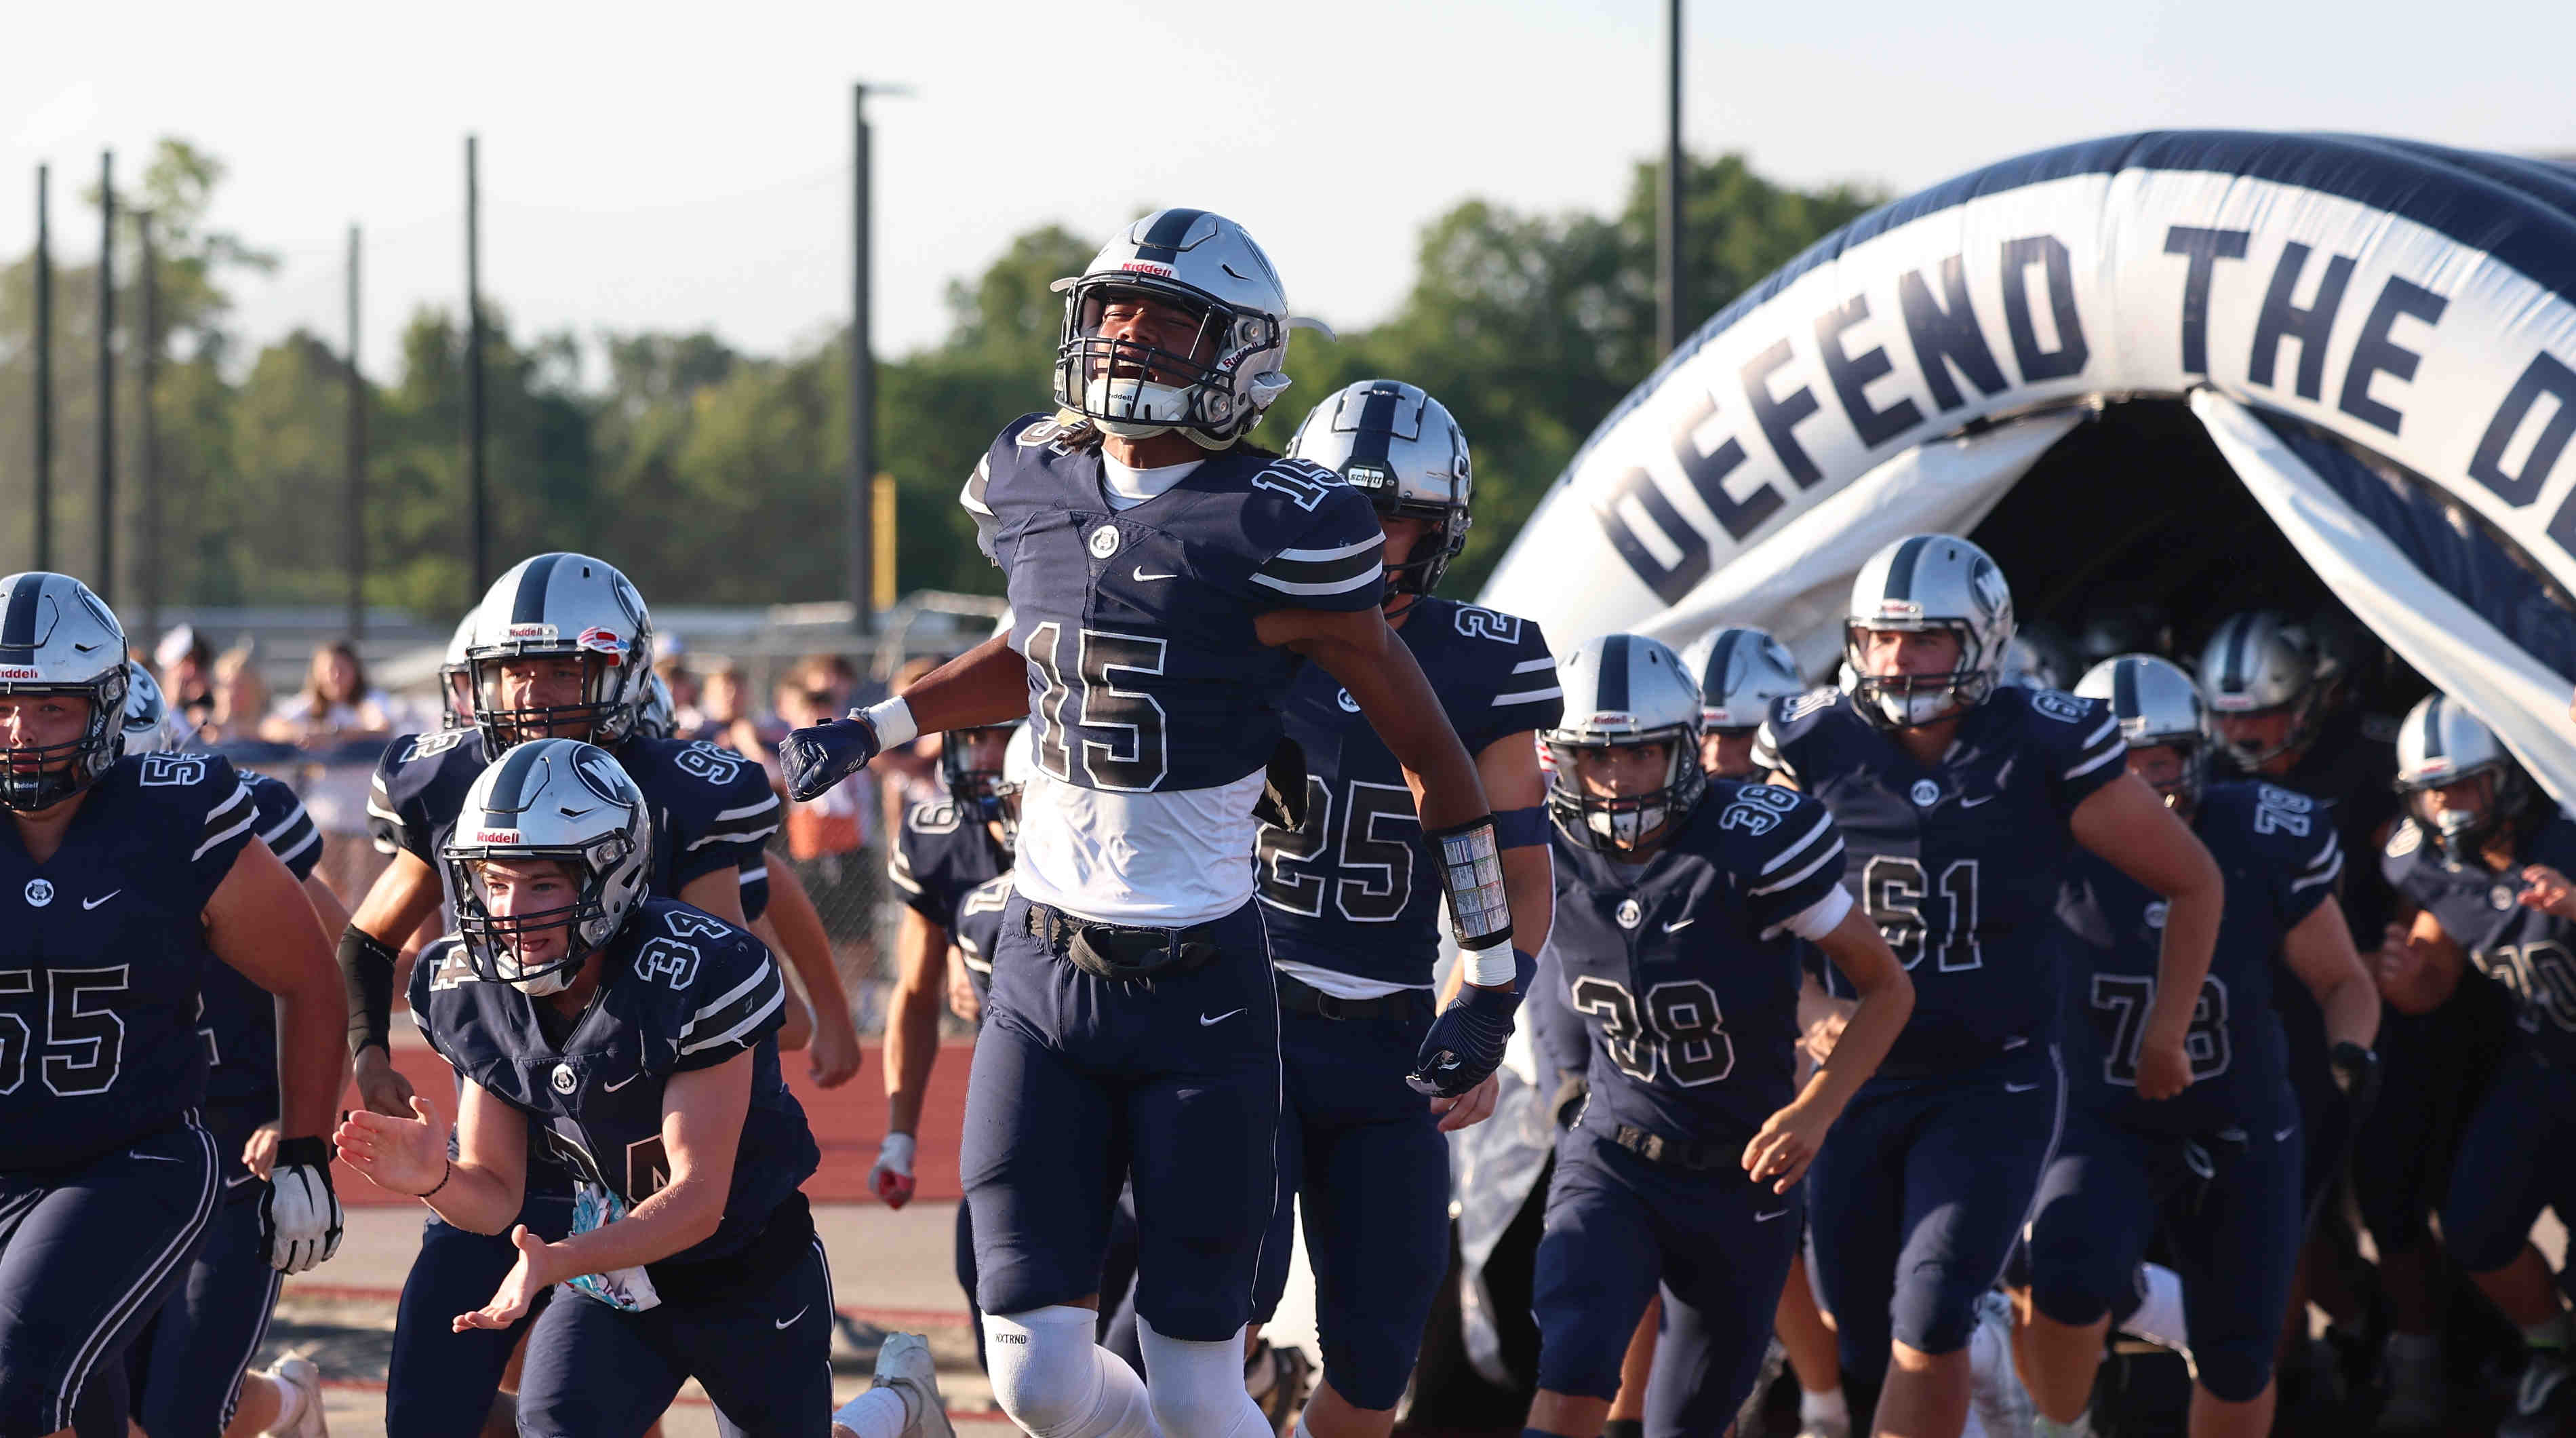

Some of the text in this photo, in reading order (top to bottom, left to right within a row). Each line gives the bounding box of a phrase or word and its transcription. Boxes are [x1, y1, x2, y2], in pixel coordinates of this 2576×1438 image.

[1122, 262, 1172, 277] Riddell
[1592, 235, 2089, 607] DEFEND
[2163, 225, 2449, 438] THE
[0, 667, 39, 679] iddell
[510, 627, 542, 637] Riddell
[1025, 621, 1168, 793] 15
[477, 832, 519, 843] Riddell
[1254, 774, 1421, 922] 25
[634, 910, 733, 992] 34
[1863, 854, 1983, 973] 61
[1570, 975, 1736, 1087] 38
[995, 1333, 1027, 1344] NXTRND
